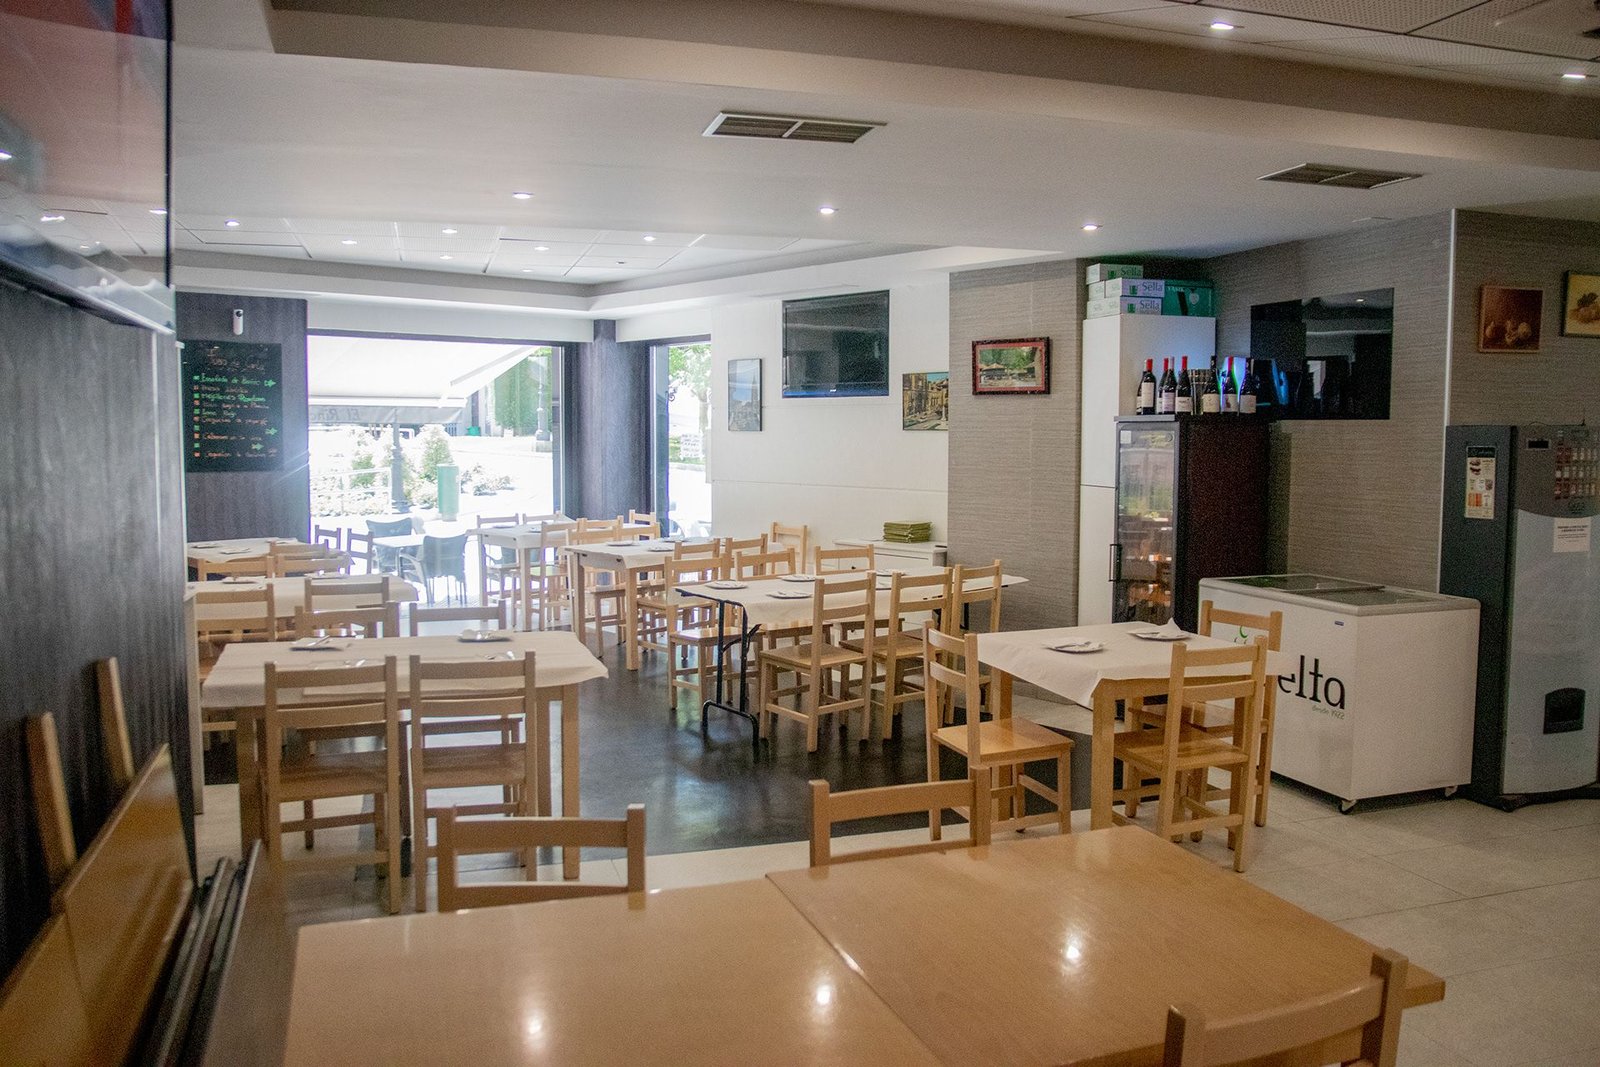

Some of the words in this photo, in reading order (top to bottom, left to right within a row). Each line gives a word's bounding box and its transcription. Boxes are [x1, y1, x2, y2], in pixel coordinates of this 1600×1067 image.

[1120, 267, 1142, 276] Sella
[1142, 280, 1163, 292] Sella
[1140, 299, 1160, 310] Sella
[1277, 655, 1346, 710] elta
